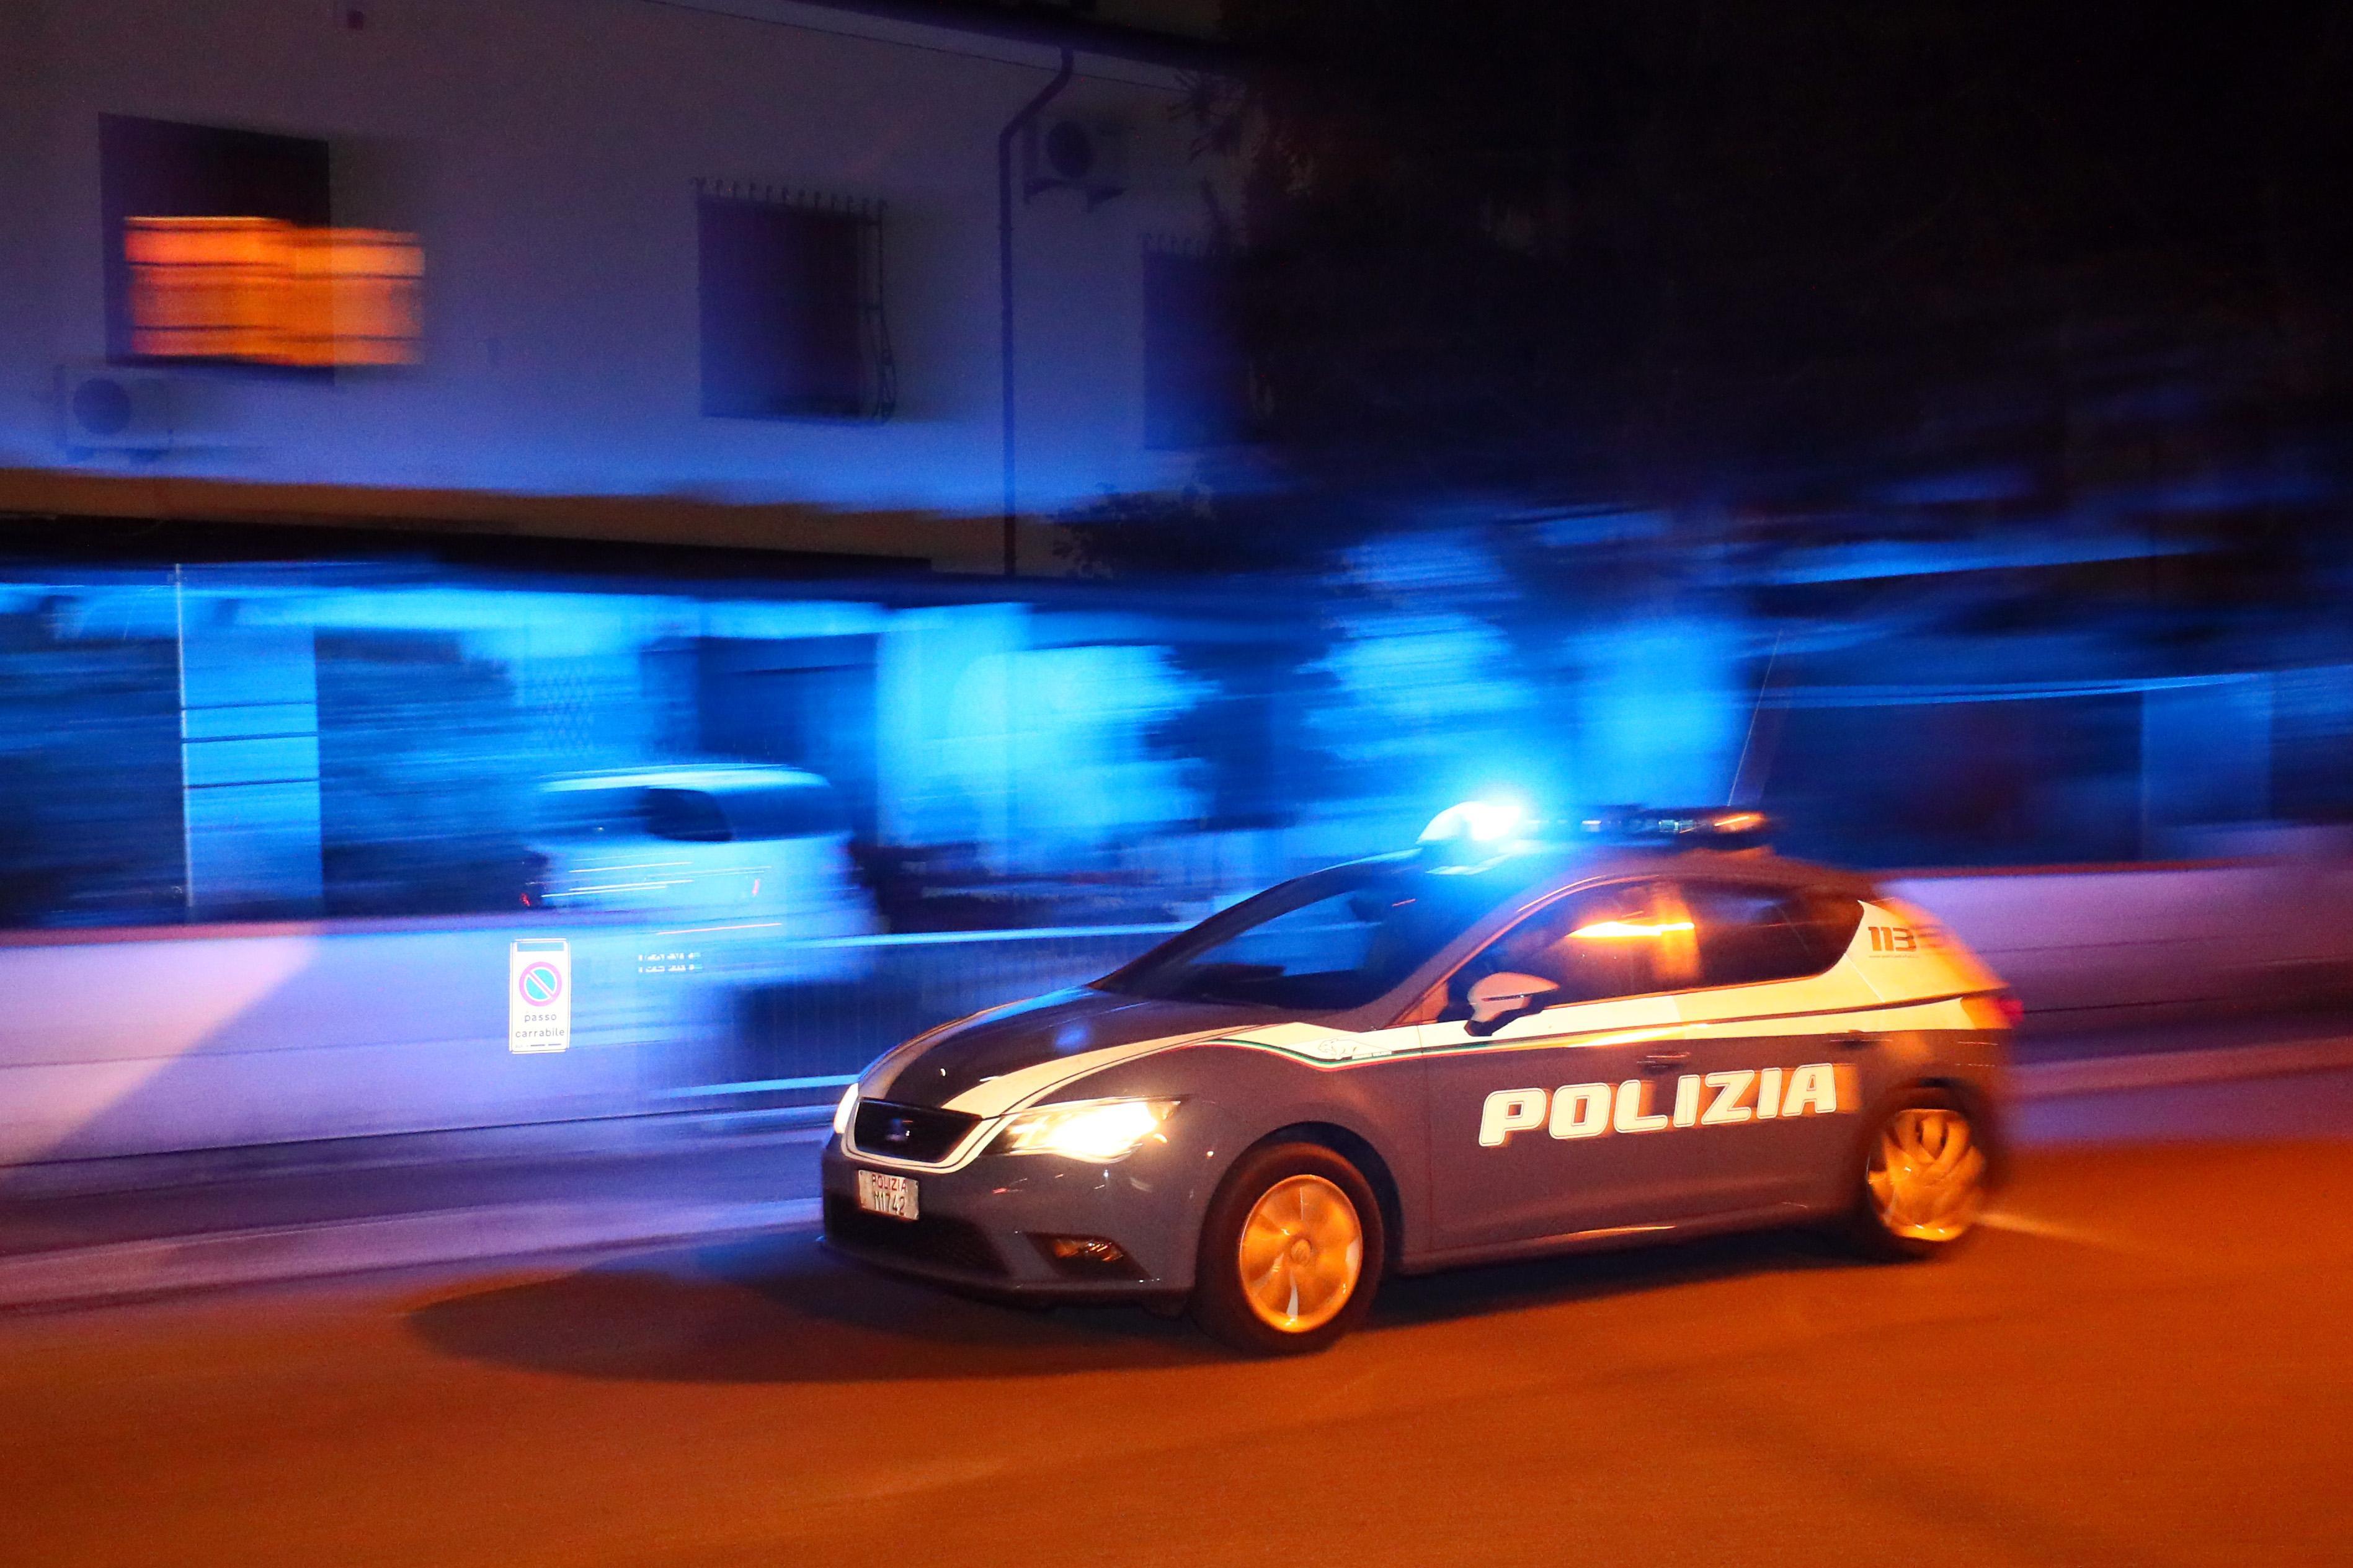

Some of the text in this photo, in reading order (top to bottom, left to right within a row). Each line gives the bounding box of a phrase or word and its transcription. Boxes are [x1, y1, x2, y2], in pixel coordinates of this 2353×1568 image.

[1868, 926, 1916, 952] 113
[524, 1014, 556, 1022] passo
[515, 1029, 565, 1038] carrabile
[1479, 1063, 1837, 1146] POLIZIA
[872, 1174, 907, 1192] POLIZIA
